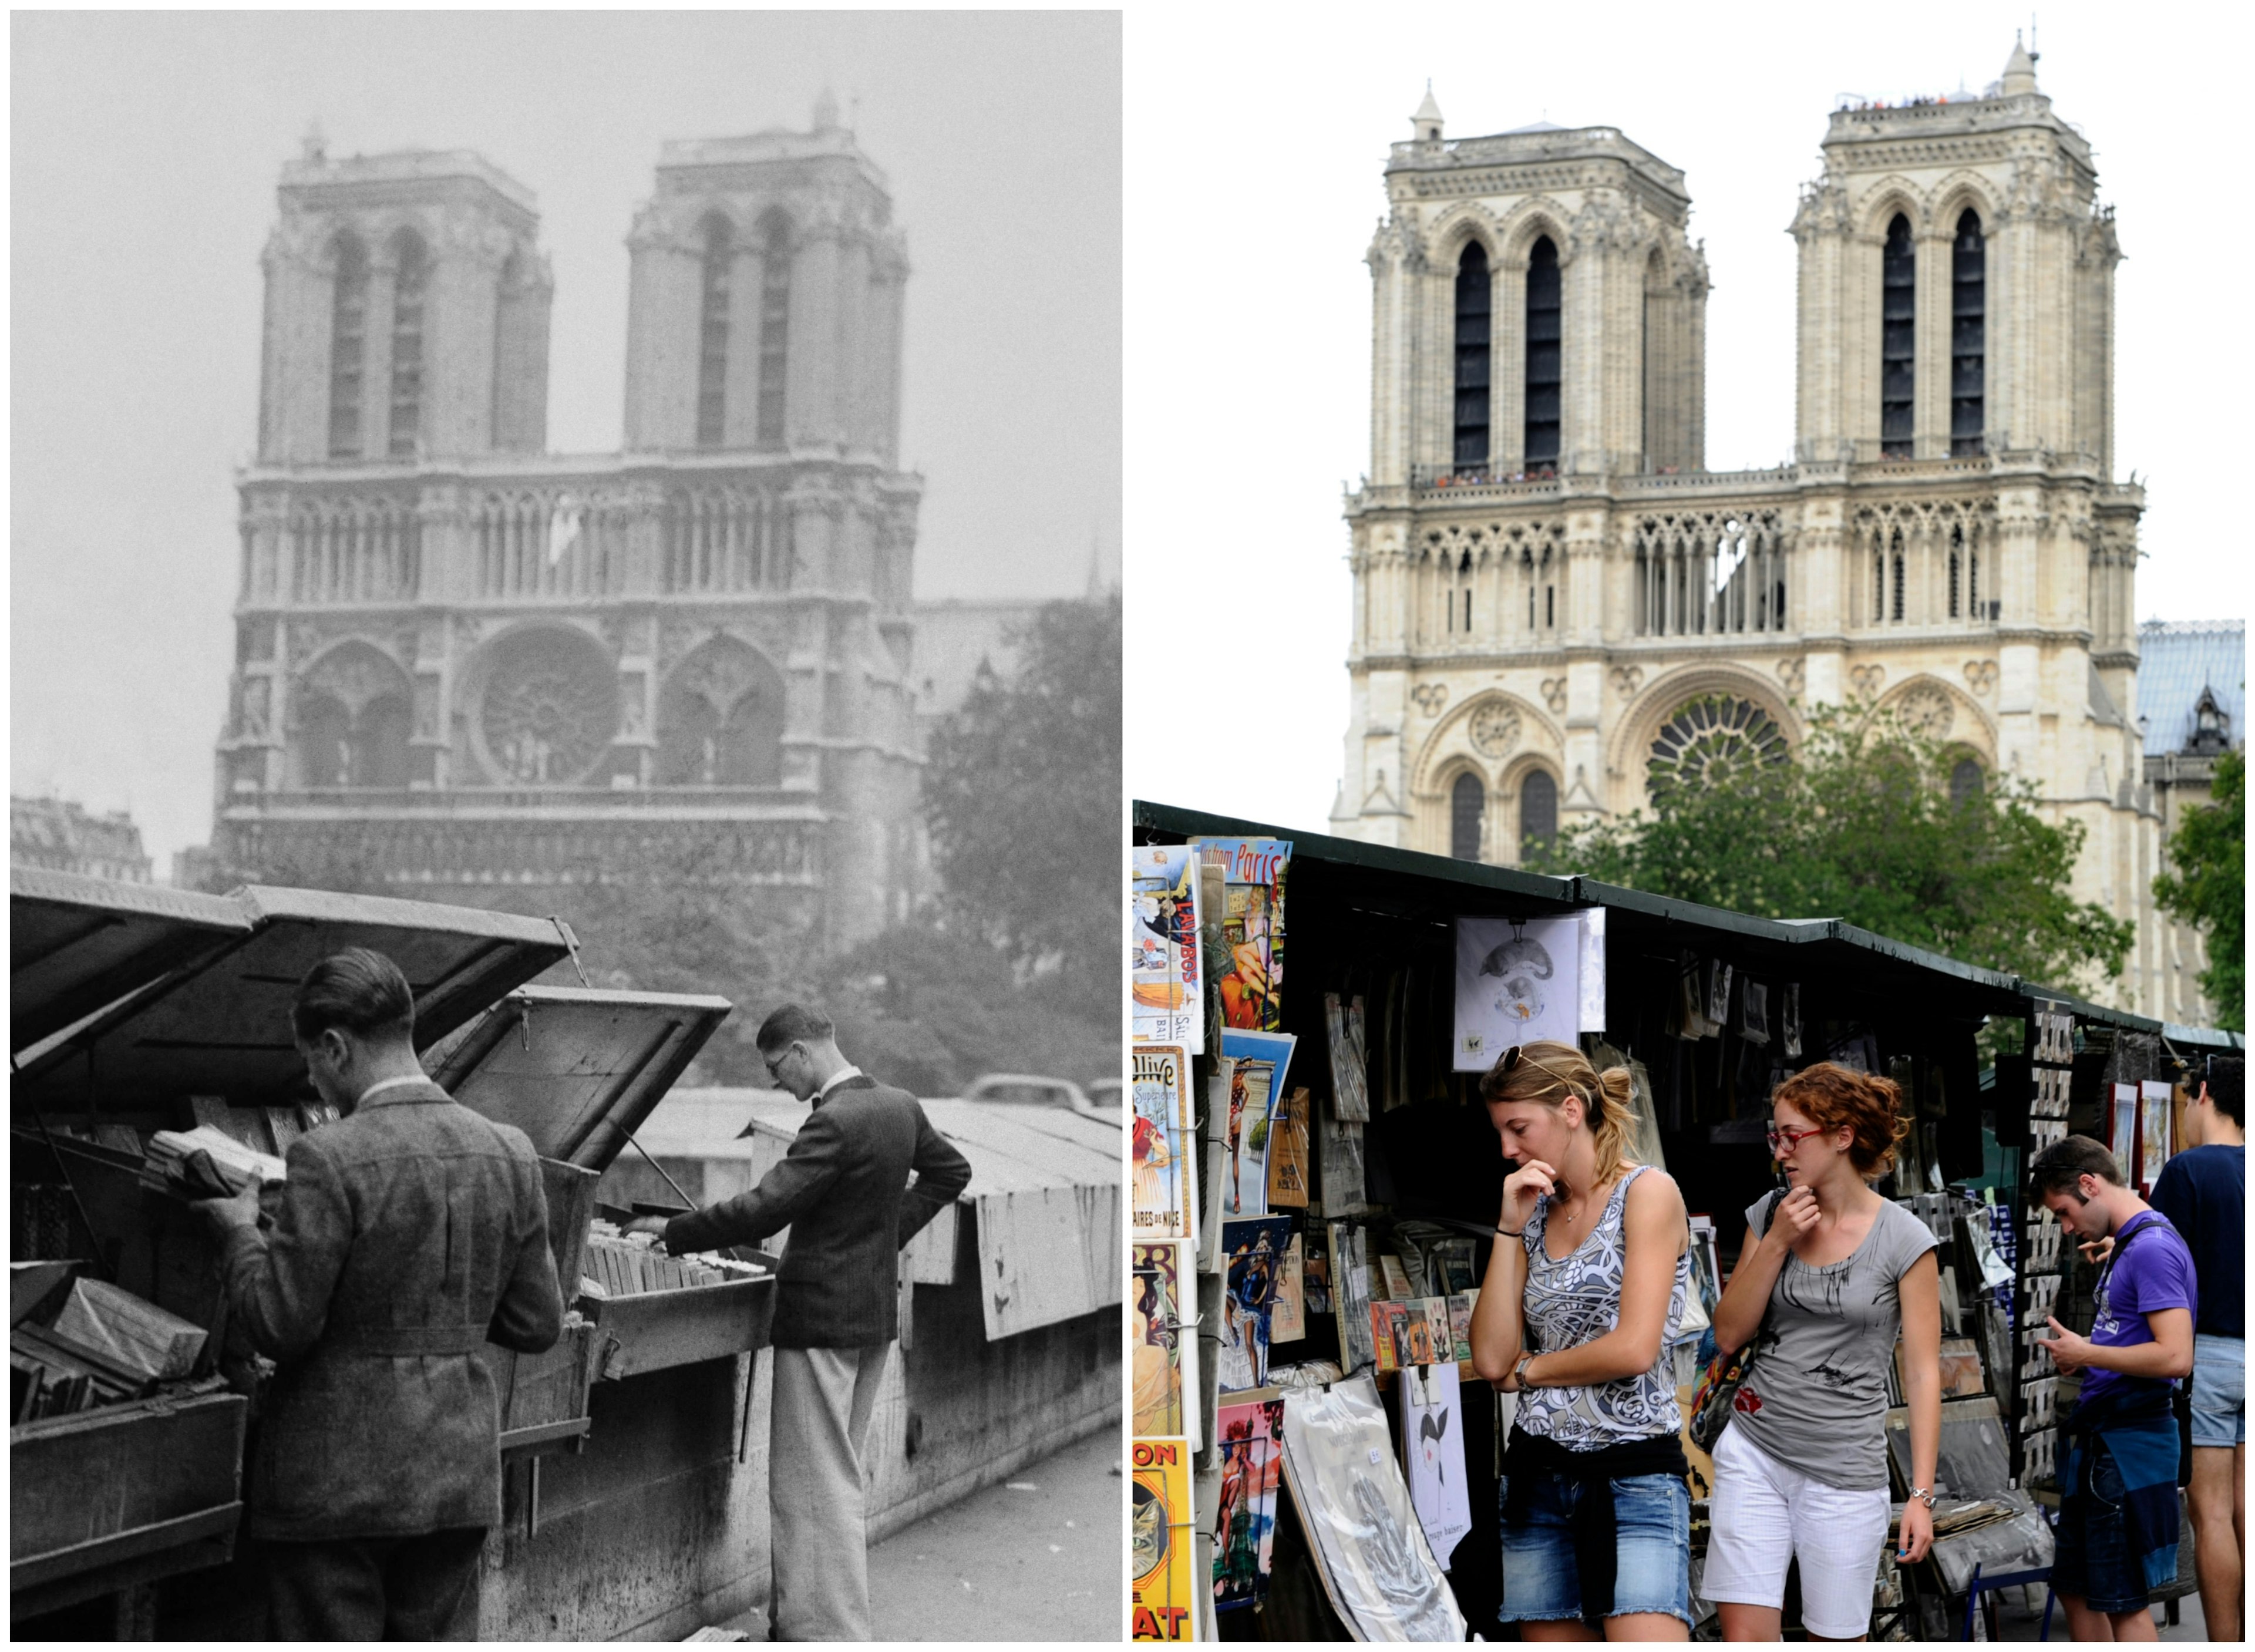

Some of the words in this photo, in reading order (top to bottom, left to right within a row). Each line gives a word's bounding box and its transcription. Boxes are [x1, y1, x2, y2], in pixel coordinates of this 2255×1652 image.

[1236, 844, 1281, 902] Paris
[1176, 902, 1198, 984] LAVABOS
[1469, 1039, 1479, 1049] 4€
[1155, 1214, 1162, 1224] DE
[1163, 1210, 1180, 1227] NICE
[1444, 1524, 1463, 1536] baiser
